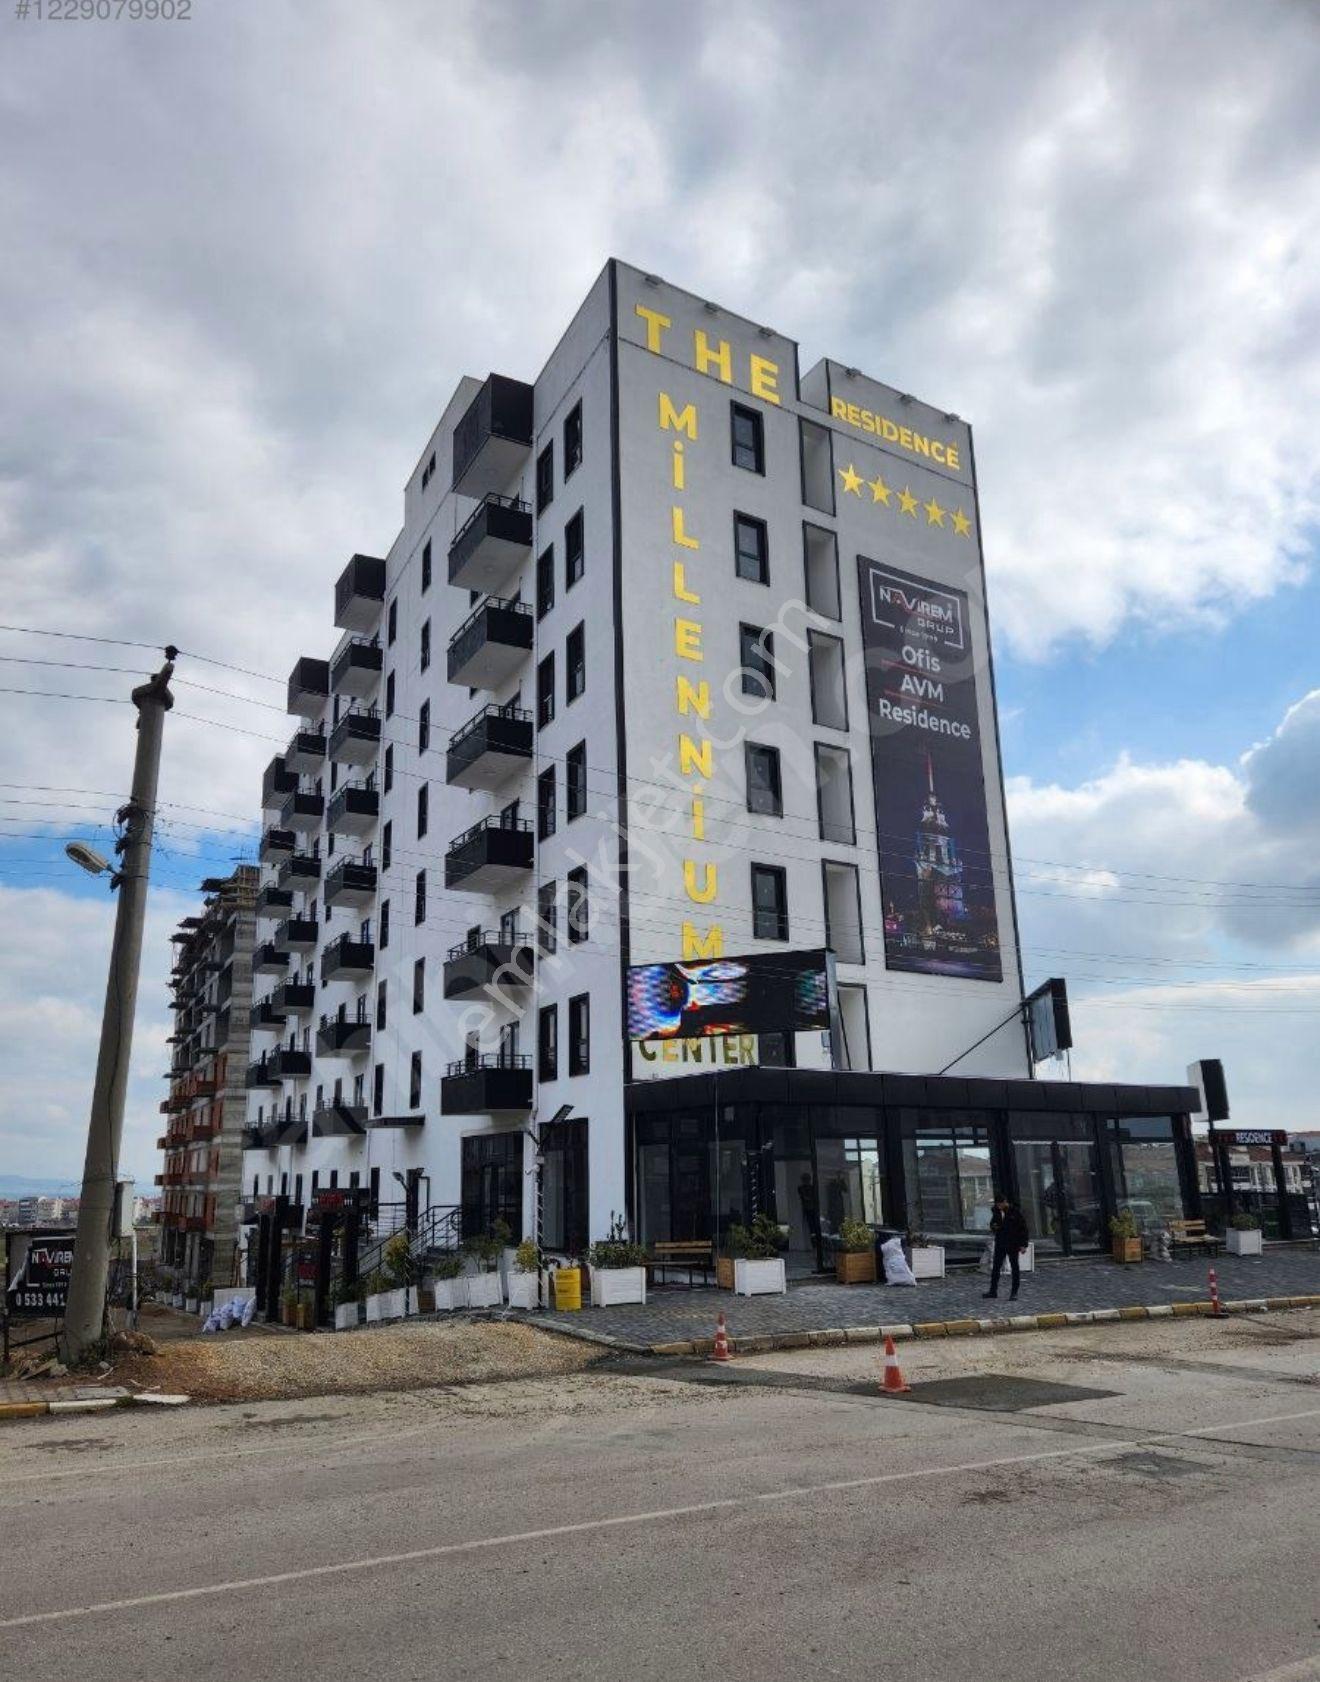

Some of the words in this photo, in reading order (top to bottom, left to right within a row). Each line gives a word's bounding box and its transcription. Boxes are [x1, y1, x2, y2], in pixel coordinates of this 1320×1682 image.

[635, 303, 781, 406] THE
[830, 395, 961, 470] RESIDENCE
[901, 644, 942, 673] Ofis
[900, 673, 945, 703] AVM
[879, 697, 973, 740] Residence
[15, 1292, 22, 1307] 0
[24, 1292, 44, 1307] 533
